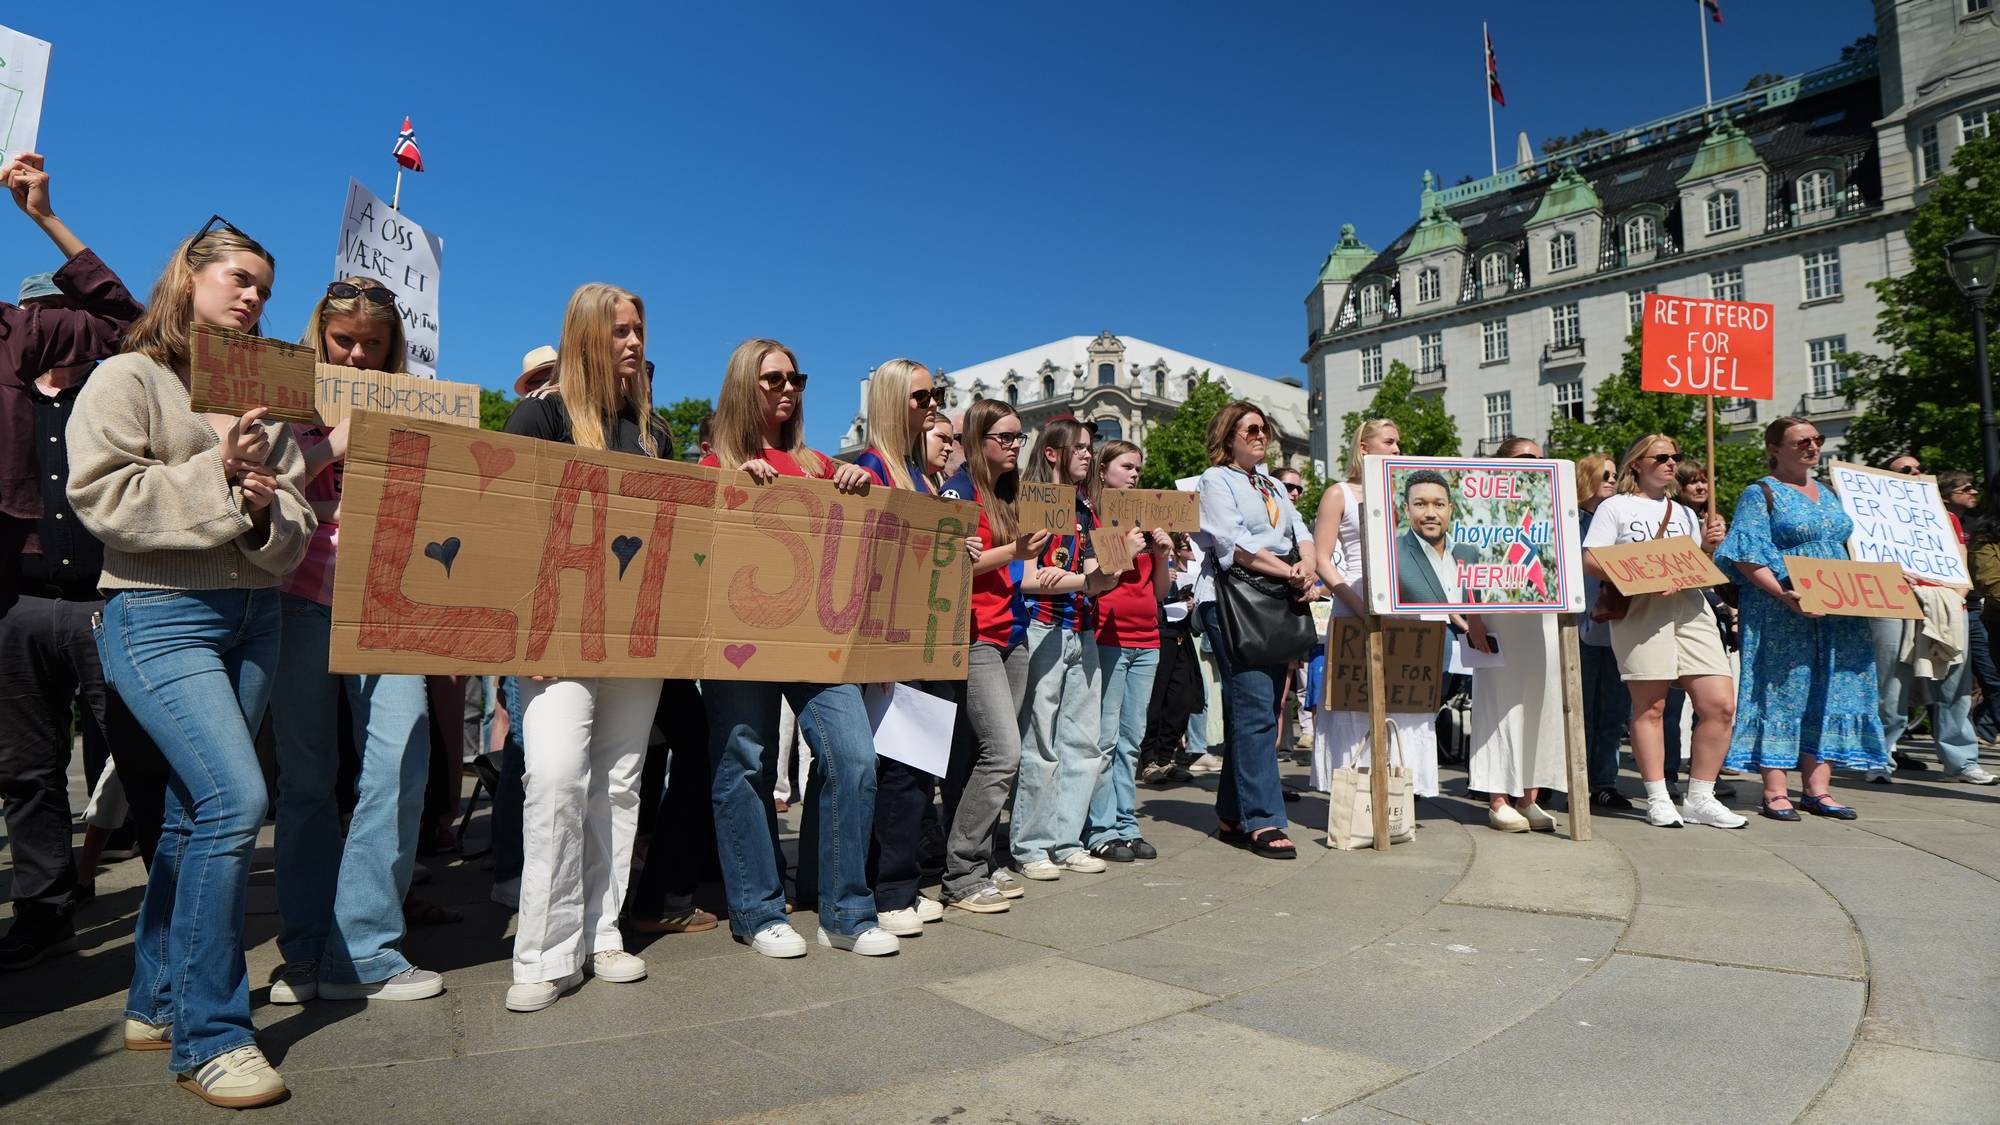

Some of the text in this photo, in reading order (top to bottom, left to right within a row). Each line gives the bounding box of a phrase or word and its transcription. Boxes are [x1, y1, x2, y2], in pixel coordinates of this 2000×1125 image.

[349, 185, 413, 251] LA OSS
[345, 229, 429, 292] VÆRE ET
[1655, 299, 1769, 331] RETTFERD
[198, 327, 269, 379] LAT
[406, 340, 434, 363] FERD
[1688, 331, 1729, 354] FOR
[1663, 354, 1749, 391] SUEL
[208, 374, 308, 409] SUEL BLI
[316, 377, 481, 419] TFERDFORSUEL
[1463, 476, 1522, 499] SUEL
[1840, 471, 1929, 505] BEVISET
[1045, 509, 1070, 529] NO!
[1852, 497, 1944, 530] ER DER
[358, 428, 718, 663] LAT
[1453, 520, 1549, 548] høyrer til
[1857, 519, 1944, 552] VILJEN
[728, 483, 912, 643] SUEL
[1456, 563, 1527, 589] HER!!!
[1860, 540, 1965, 579] MANGLER
[1671, 574, 1707, 588] DERE
[1816, 569, 1905, 610] SUEL
[1340, 624, 1432, 659] RTT
[1401, 663, 1432, 682] FOR
